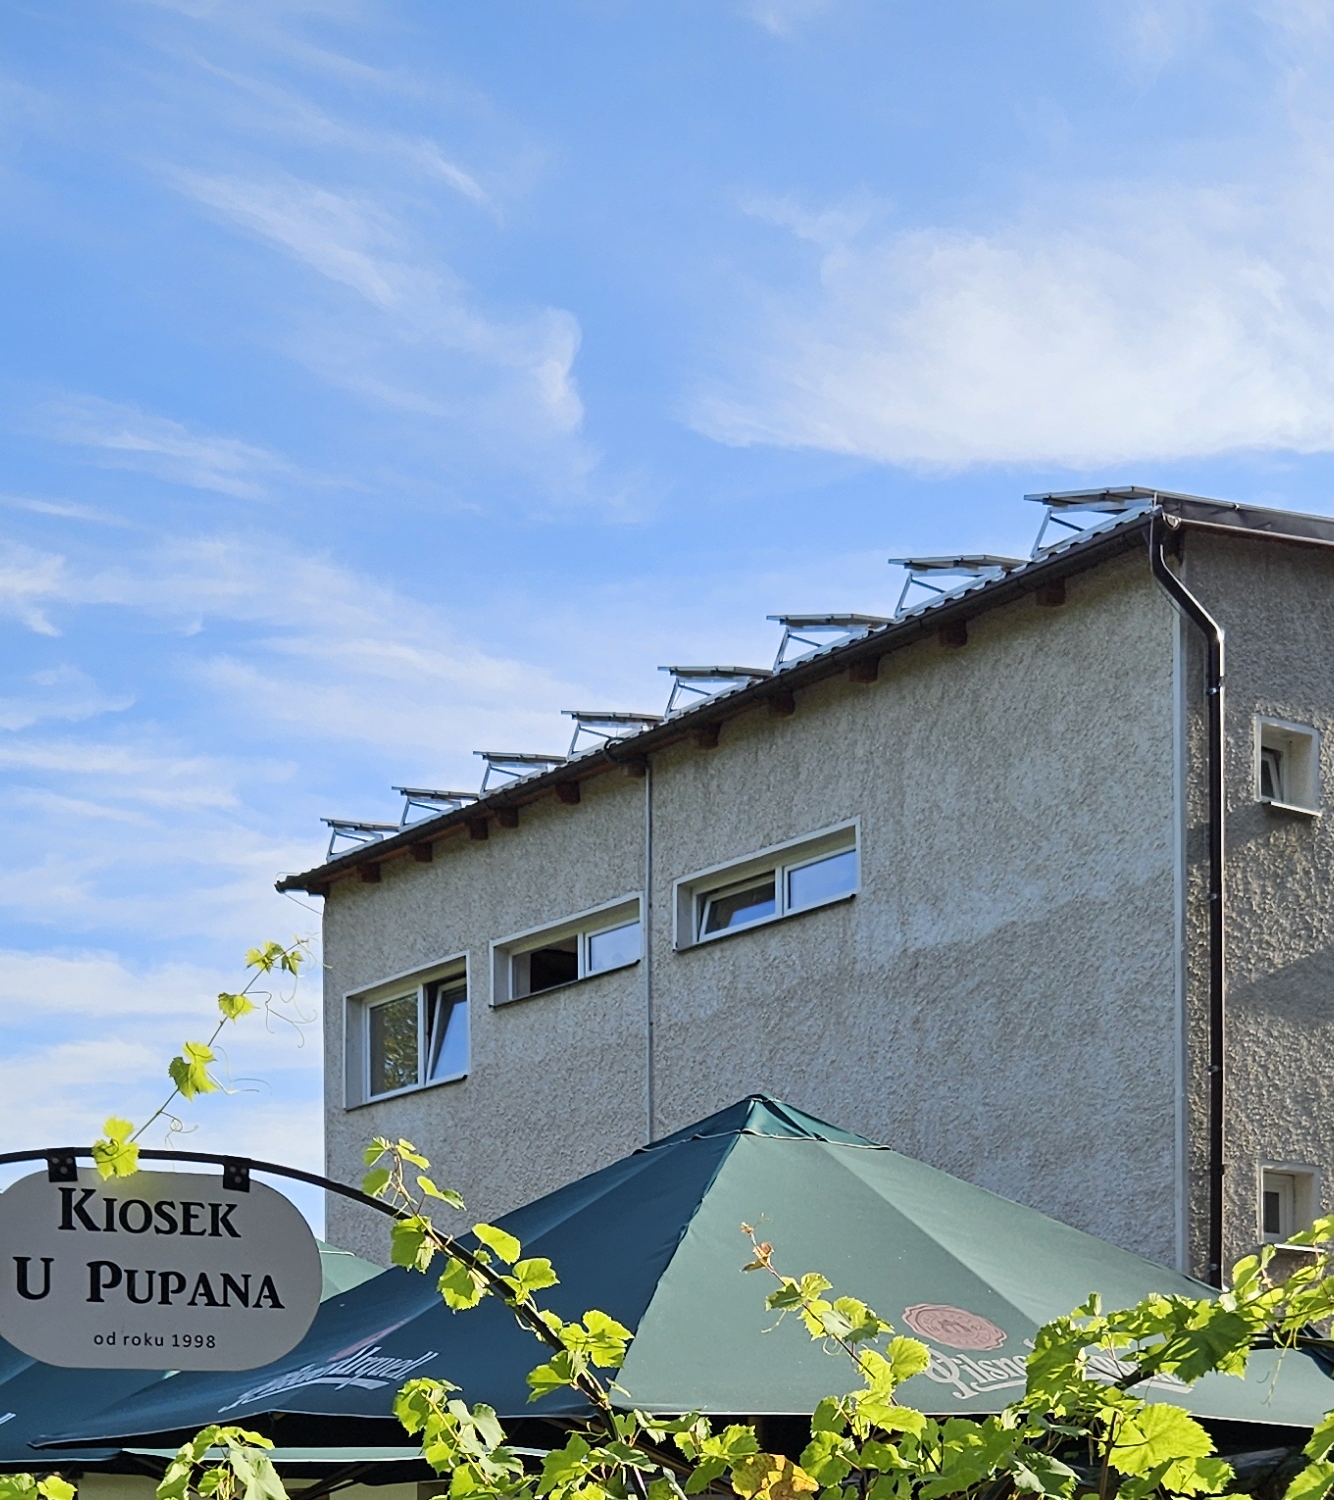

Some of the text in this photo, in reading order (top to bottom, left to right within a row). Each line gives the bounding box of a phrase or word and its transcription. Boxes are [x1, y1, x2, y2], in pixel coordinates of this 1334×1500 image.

[58, 1186, 242, 1239] KIOSEK
[12, 1256, 286, 1310] U PUPANA
[93, 1332, 216, 1349] od roku 1998
